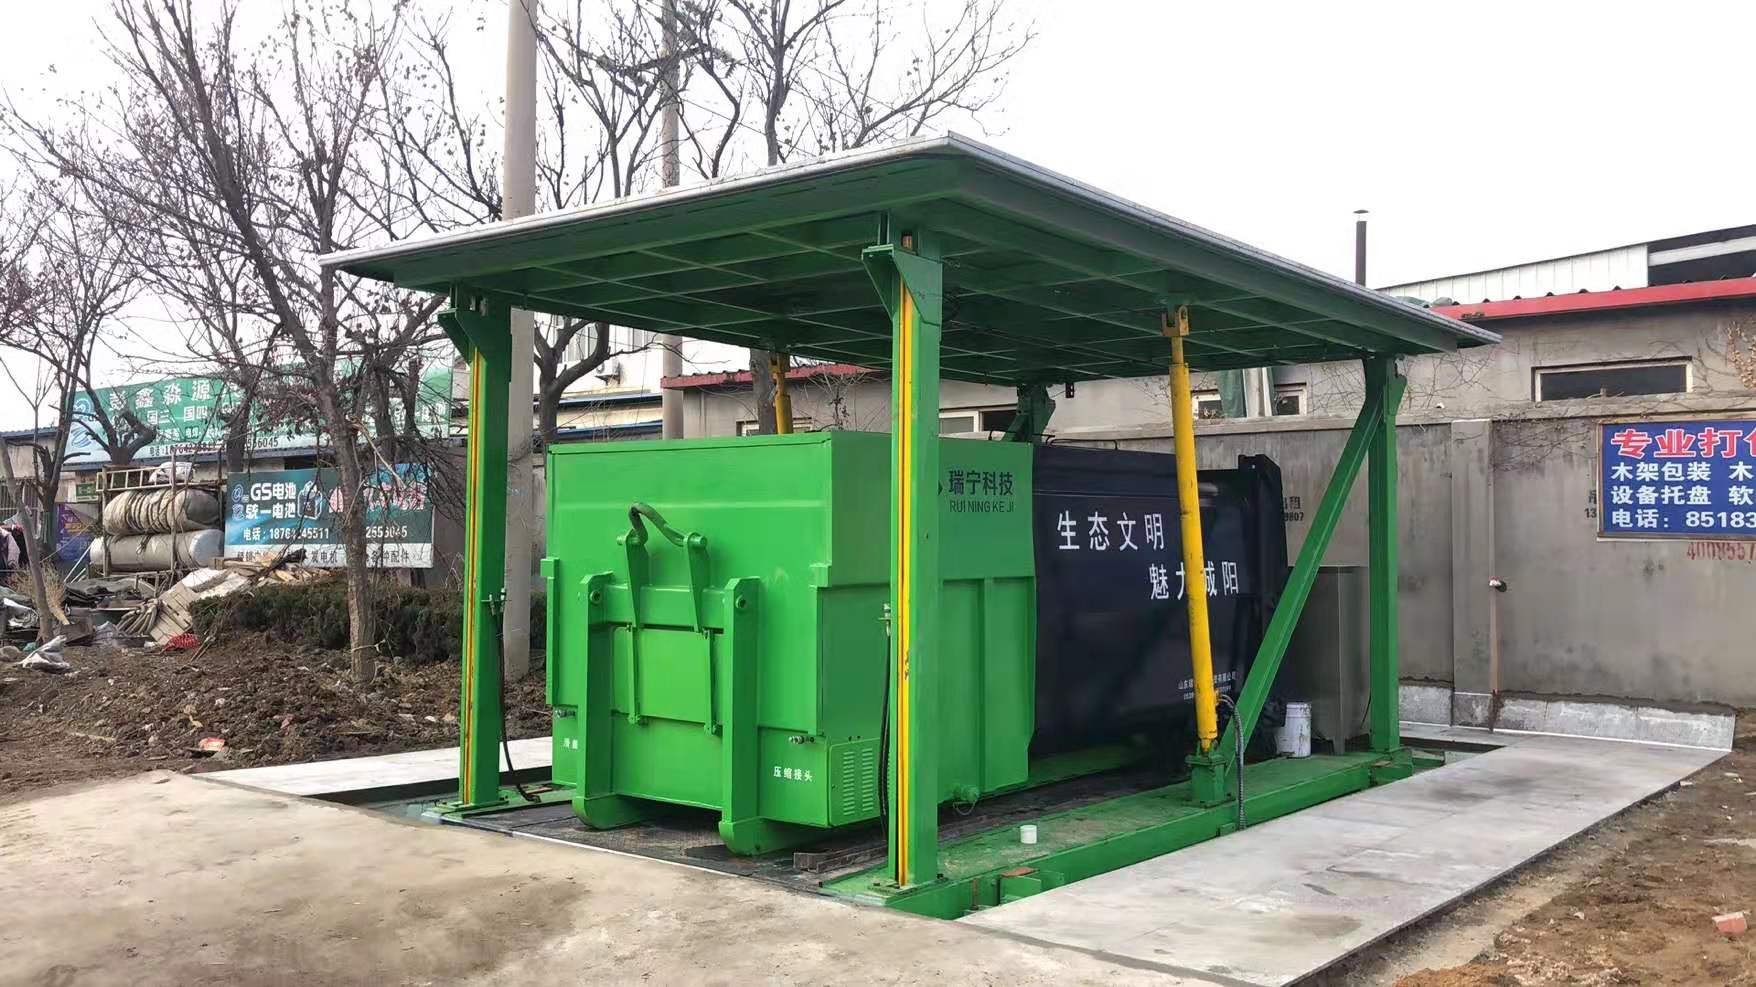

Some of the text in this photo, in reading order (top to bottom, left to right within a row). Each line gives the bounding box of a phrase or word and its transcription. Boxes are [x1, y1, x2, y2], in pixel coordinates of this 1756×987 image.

[1611, 461, 1754, 482] 木架包装 木
[250, 481, 297, 501] GS电池
[948, 469, 1013, 496] 瑞宁科技
[1611, 485, 1712, 506] 设备托盘
[1728, 485, 1754, 506] 软
[1057, 510, 1165, 551] 生态文明
[773, 766, 813, 782] 压缩接头
